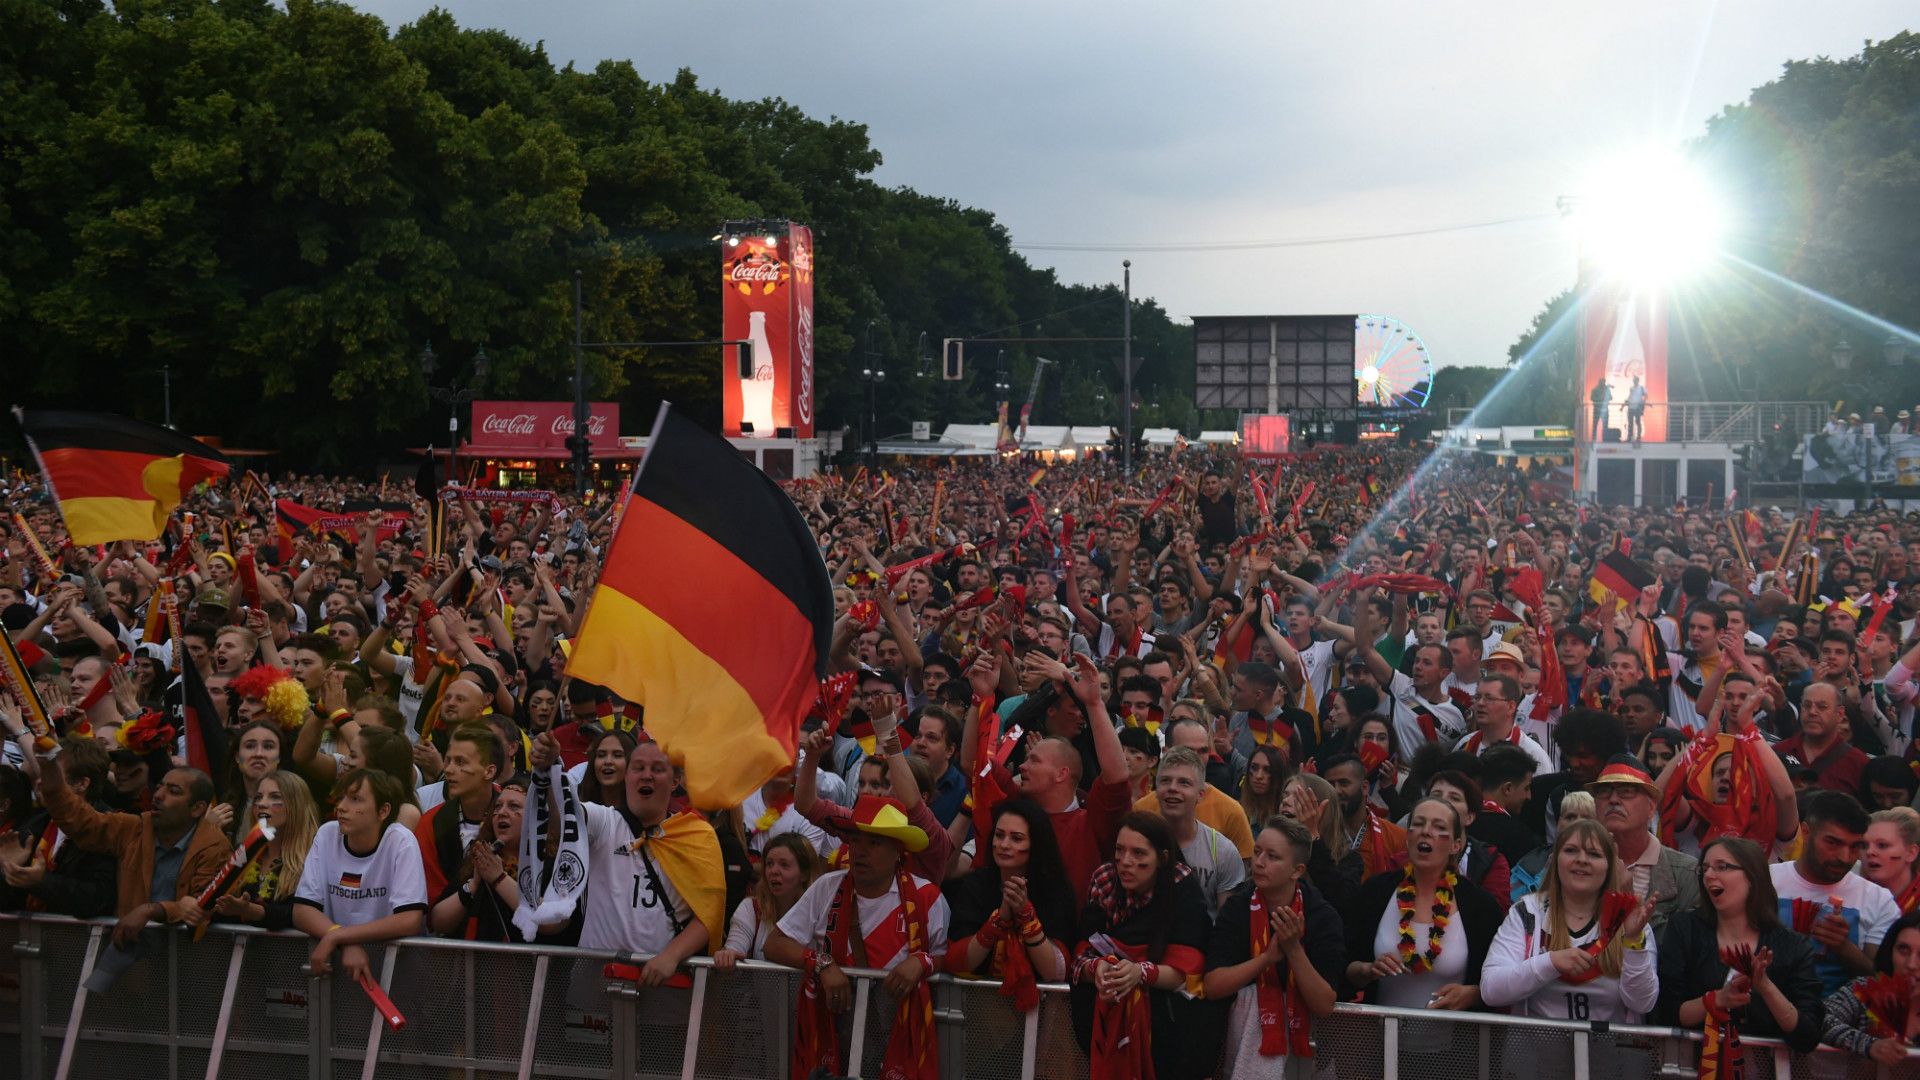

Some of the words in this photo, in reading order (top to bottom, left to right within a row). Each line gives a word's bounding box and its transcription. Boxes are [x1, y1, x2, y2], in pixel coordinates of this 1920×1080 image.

[731, 263, 780, 282] Coca-Cola
[797, 297, 811, 425] Coca-Cola
[482, 413, 538, 435] Coca-Cola
[475, 489, 508, 498] BAYERN
[632, 874, 658, 908] 13
[1564, 992, 1590, 1020] 18
